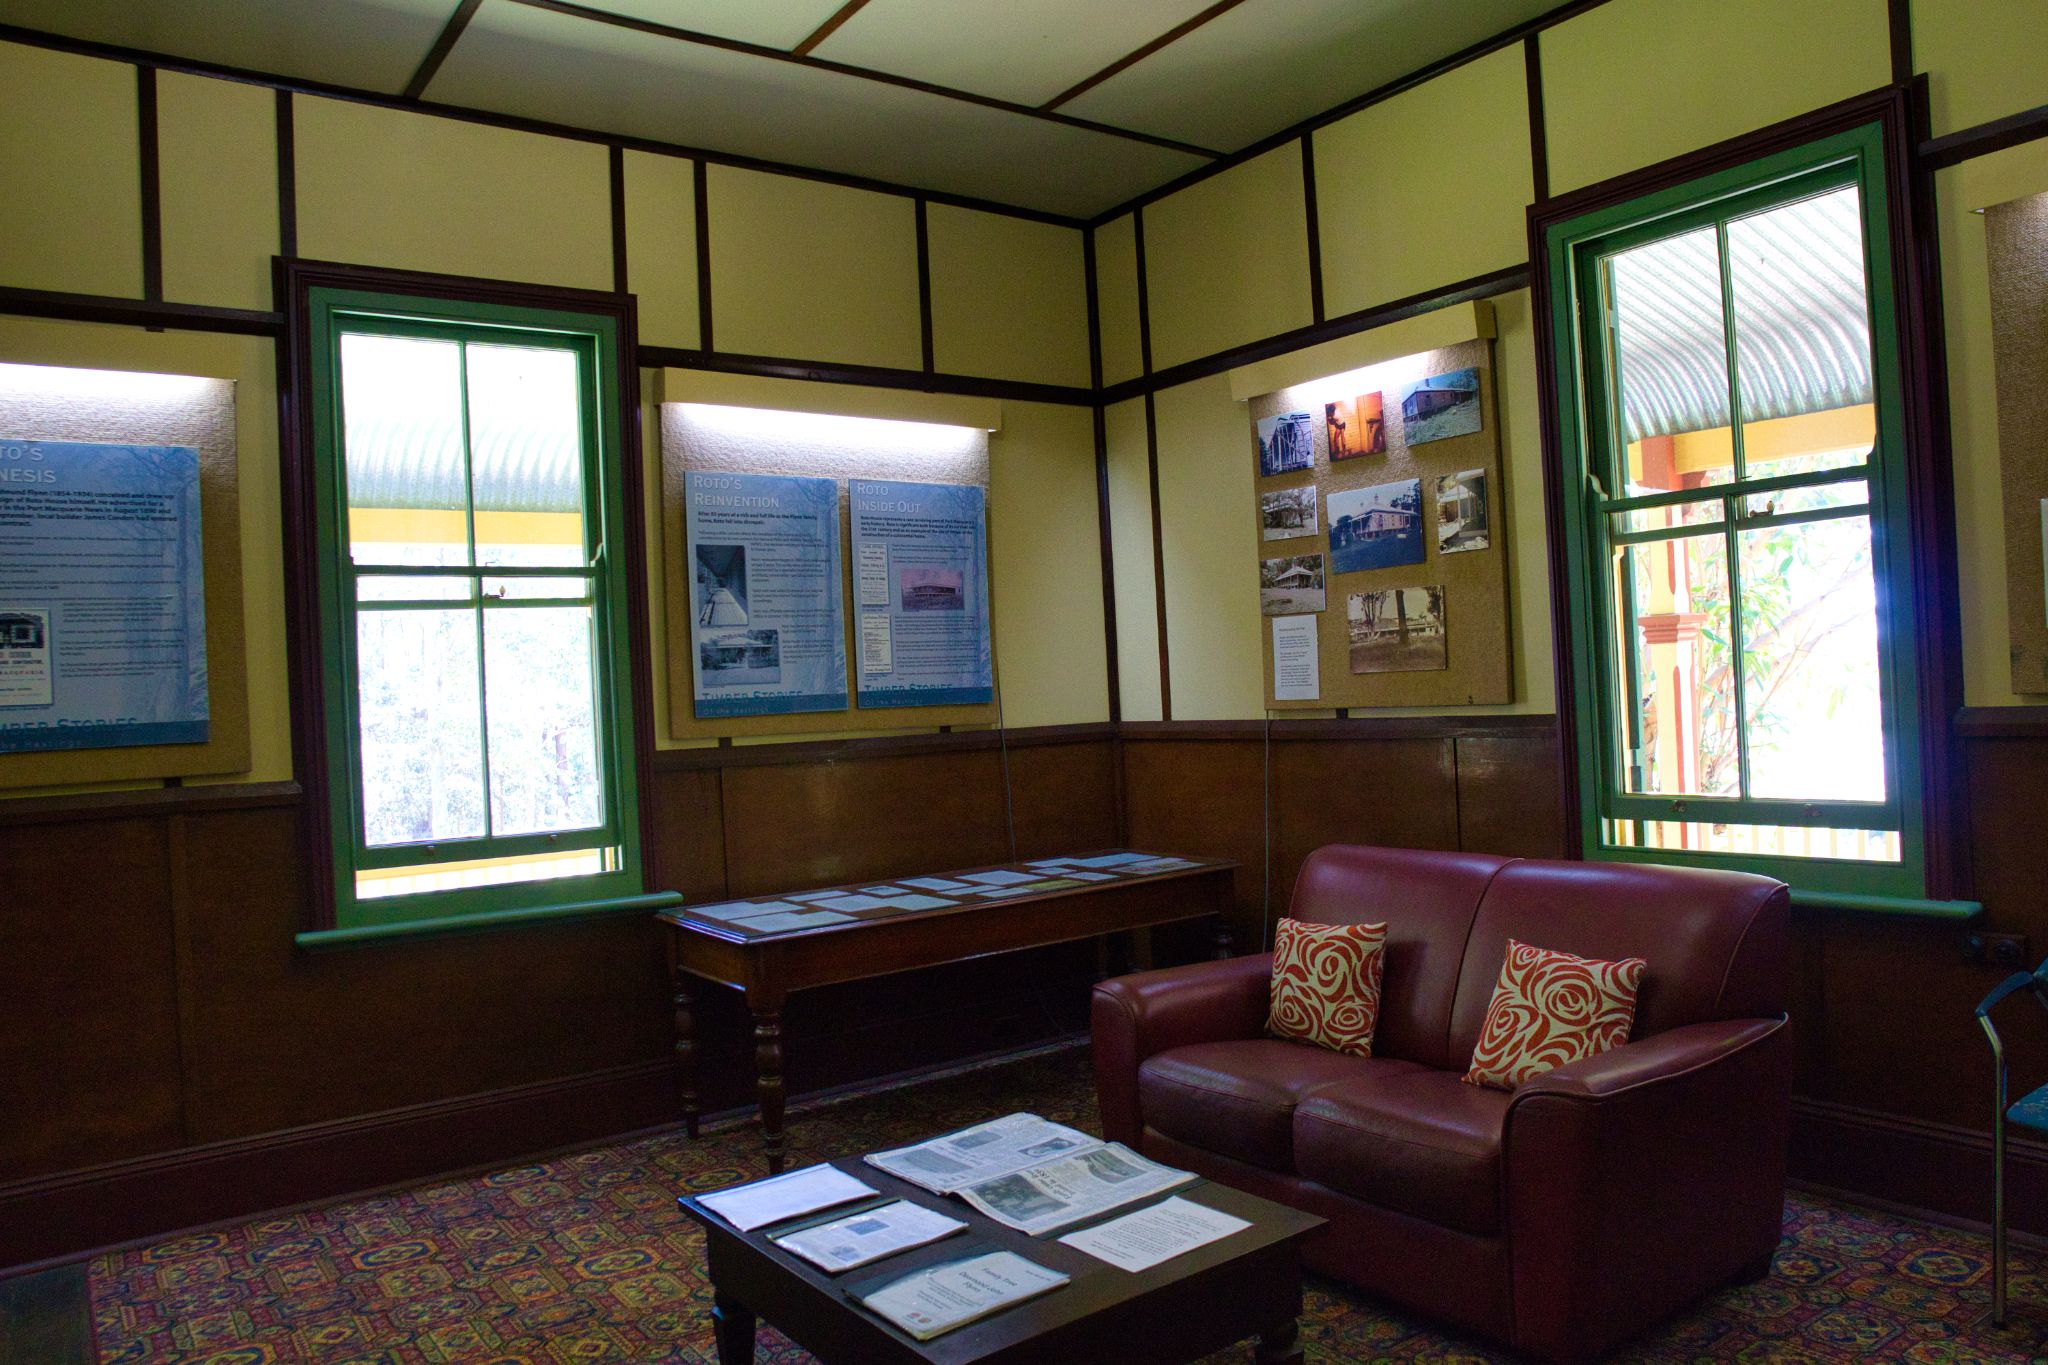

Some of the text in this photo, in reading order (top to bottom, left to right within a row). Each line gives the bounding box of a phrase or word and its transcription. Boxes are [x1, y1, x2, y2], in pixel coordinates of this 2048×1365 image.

[693, 475, 743, 490] ROTO'S
[857, 482, 889, 496] ROTO
[694, 493, 780, 508] REINVENTION
[857, 500, 921, 513] INSIDE OUT
